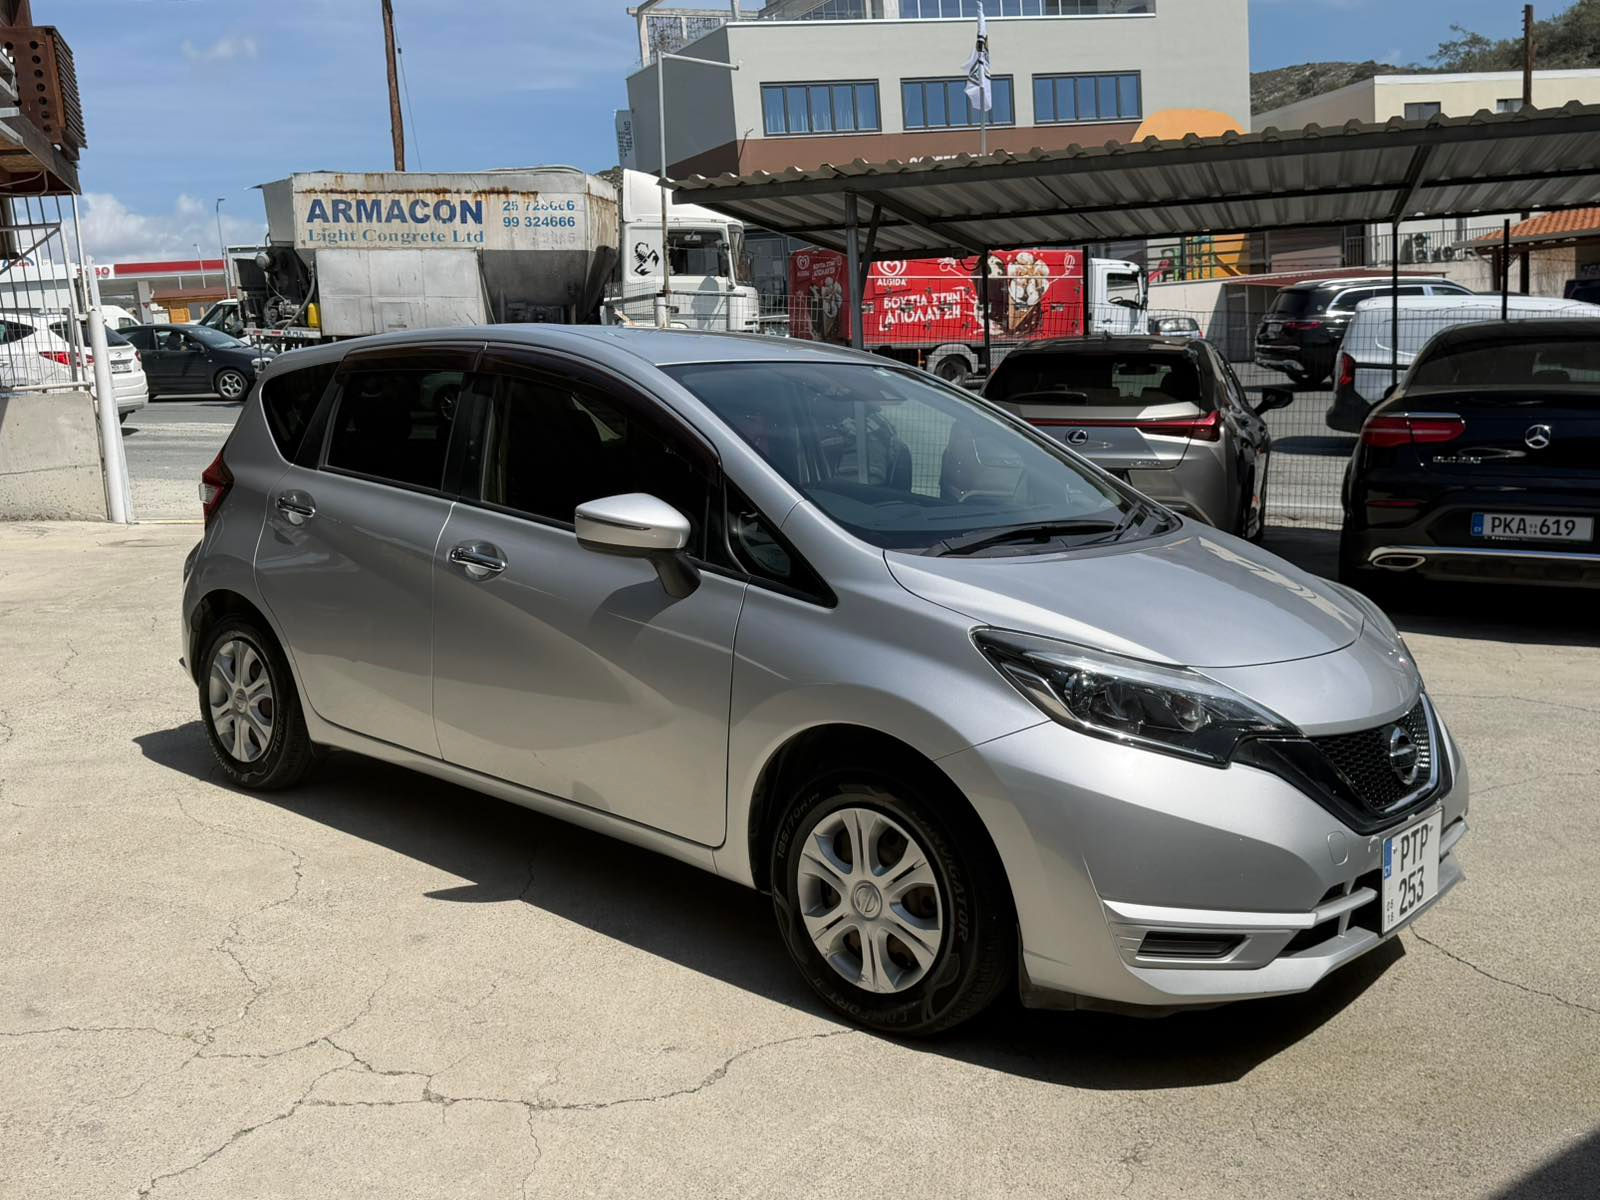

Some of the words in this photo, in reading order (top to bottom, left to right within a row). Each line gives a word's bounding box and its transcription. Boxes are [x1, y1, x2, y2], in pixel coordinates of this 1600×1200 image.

[306, 198, 483, 224] ARMACON
[503, 216, 520, 227] 99
[525, 216, 576, 228] 324666
[308, 228, 356, 246] Light
[453, 230, 484, 243] Ltd
[1491, 516, 1527, 534] PKA
[1539, 519, 1576, 536] 619
[1400, 823, 1428, 872] PTP
[1399, 865, 1424, 916] 253
